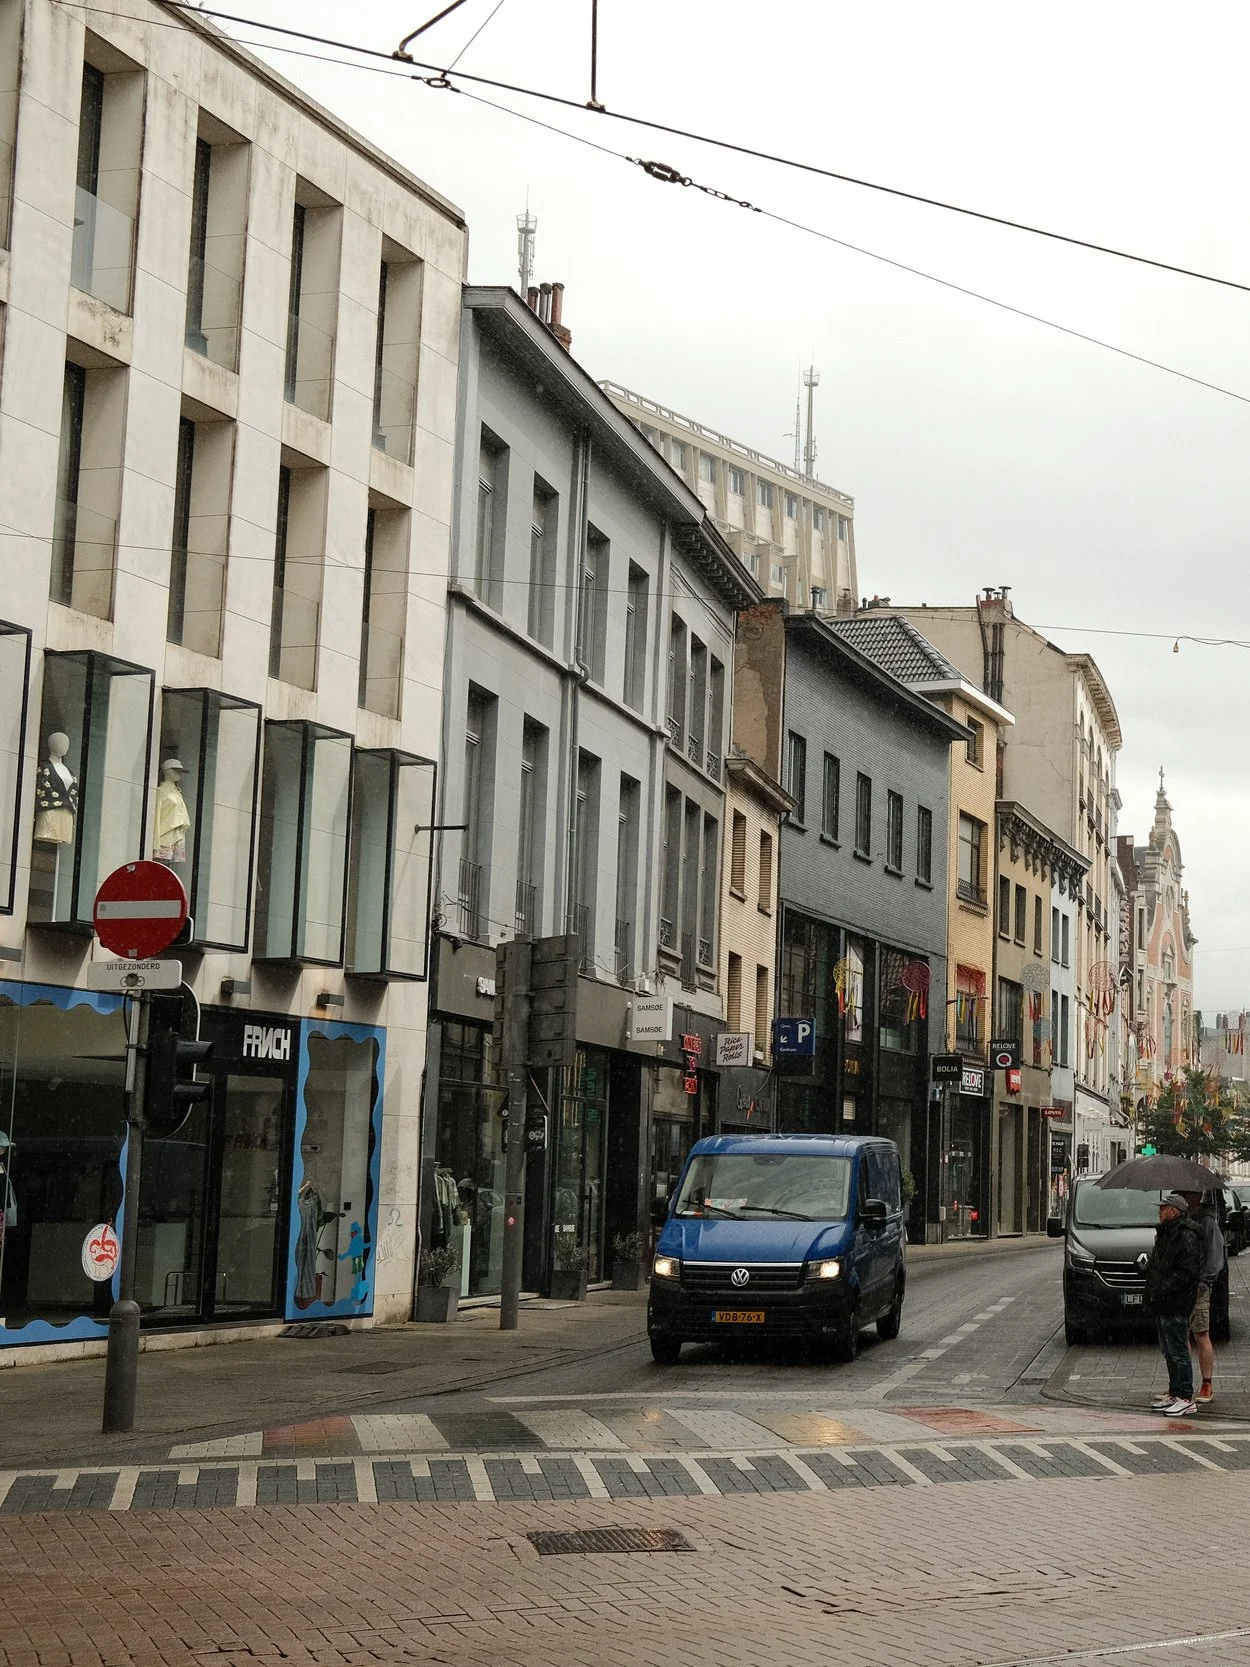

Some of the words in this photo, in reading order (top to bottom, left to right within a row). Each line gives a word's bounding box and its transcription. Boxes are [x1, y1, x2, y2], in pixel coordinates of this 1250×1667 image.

[106, 962, 161, 971] UITGEZONDERD
[797, 1023, 811, 1043] P
[724, 1036, 743, 1046] Rice
[719, 1043, 745, 1055] Paper
[722, 1052, 742, 1062] Rolls
[936, 1065, 958, 1073] BOLIA
[961, 1071, 982, 1088] RELOVE
[719, 1313, 762, 1322] VDB-76-X
